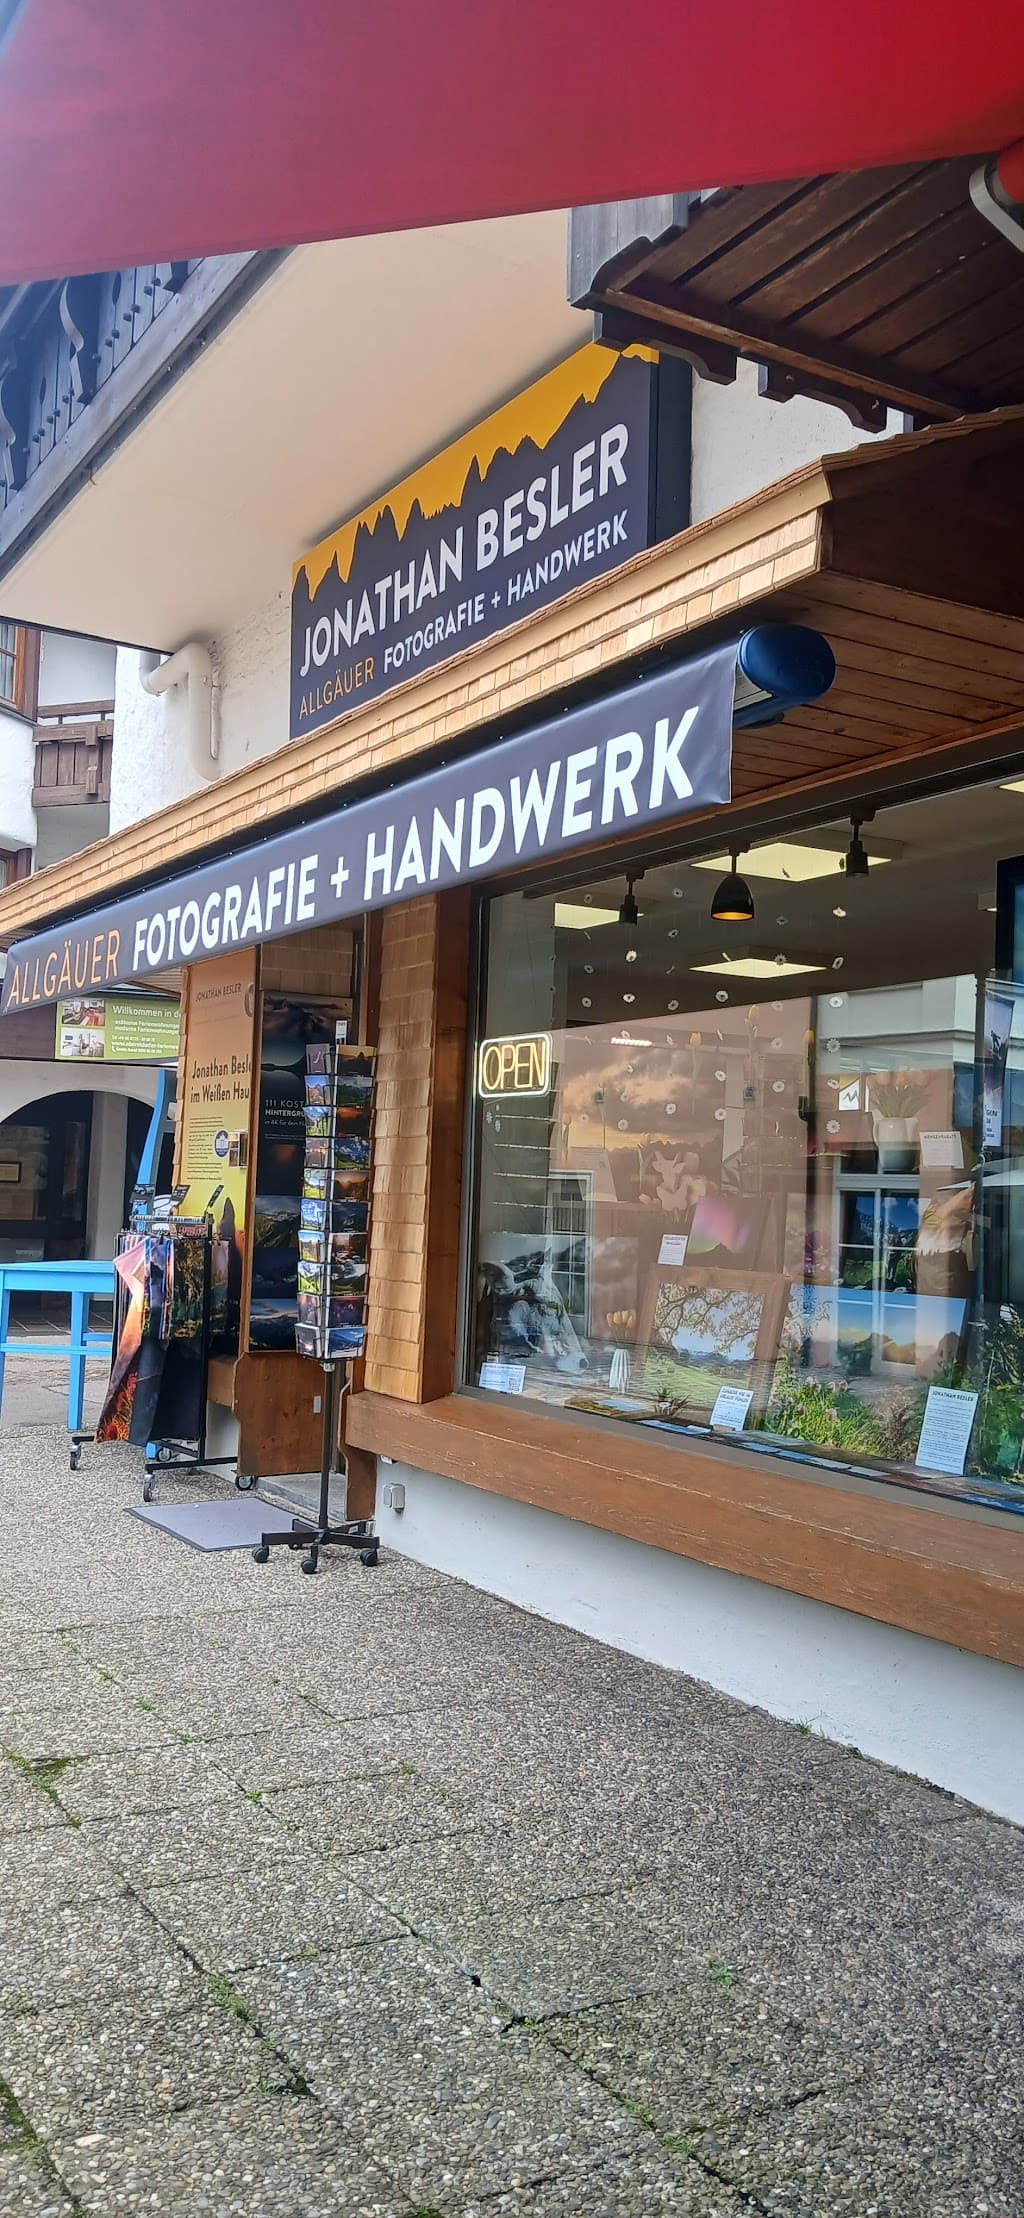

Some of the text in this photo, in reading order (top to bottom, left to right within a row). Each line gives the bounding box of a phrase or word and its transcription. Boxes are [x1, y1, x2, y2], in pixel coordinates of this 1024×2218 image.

[299, 422, 629, 678] JONATHAN BESLER
[299, 509, 628, 720] ALLGÄUER FOTOGRAFIE + HANDWERK
[6, 705, 700, 1009] ALLGÄUER FOTOGRAFIE + HANDWERK
[195, 983, 242, 1002] JONATHAN BESLER
[112, 1005, 163, 1017] Willkommen
[164, 1009, 172, 1018] in
[192, 1057, 228, 1079] Jonathan
[482, 1041, 546, 1090] OPEN
[190, 1087, 200, 1103] im
[202, 1083, 231, 1102] Weißen
